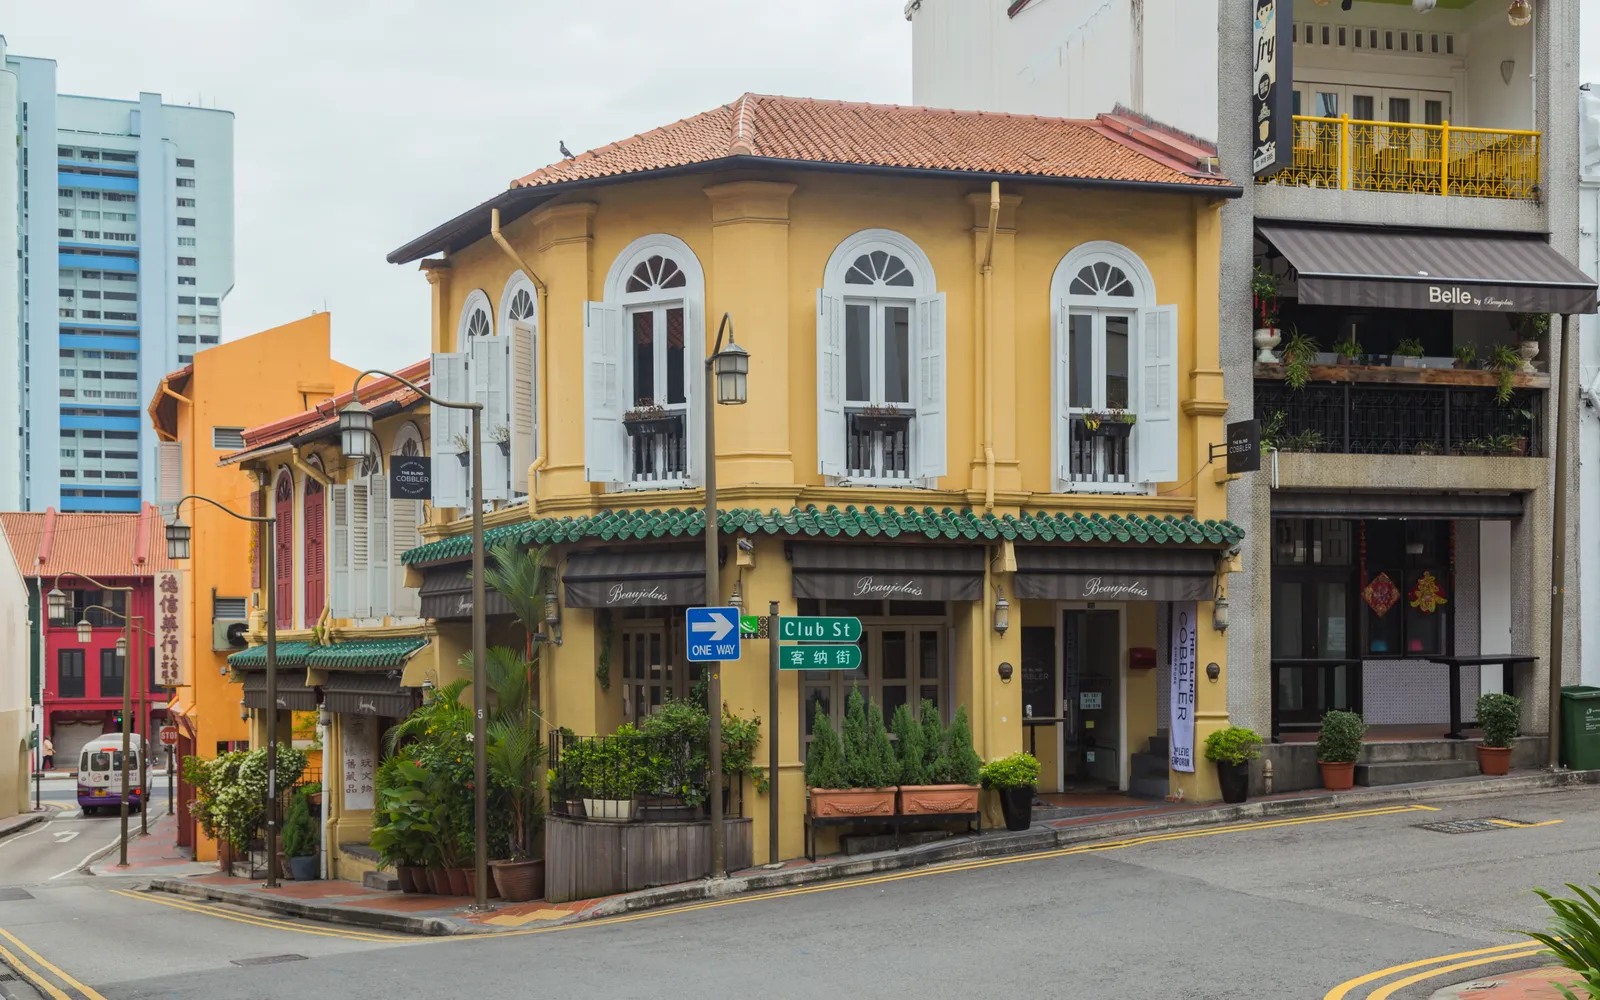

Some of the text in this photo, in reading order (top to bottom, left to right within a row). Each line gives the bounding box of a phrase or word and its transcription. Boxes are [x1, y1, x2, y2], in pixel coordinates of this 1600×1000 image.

[1254, 35, 1275, 72] fry
[1429, 286, 1471, 304] Belle
[1473, 297, 1482, 306] by
[1229, 444, 1252, 453] COBBLER
[395, 475, 430, 483] COBBLER
[605, 582, 669, 605] Beaujolais
[853, 575, 923, 599] Beaujolais
[1082, 576, 1148, 599] Beaujolais
[1552, 585, 1558, 596] 8
[785, 621, 851, 637] Club St
[691, 644, 736, 656] ONE WAY
[790, 650, 851, 665] 客纳街
[1178, 611, 1187, 720] COBBLER
[477, 708, 484, 720] 5
[1179, 747, 1190, 757] LEVEL
